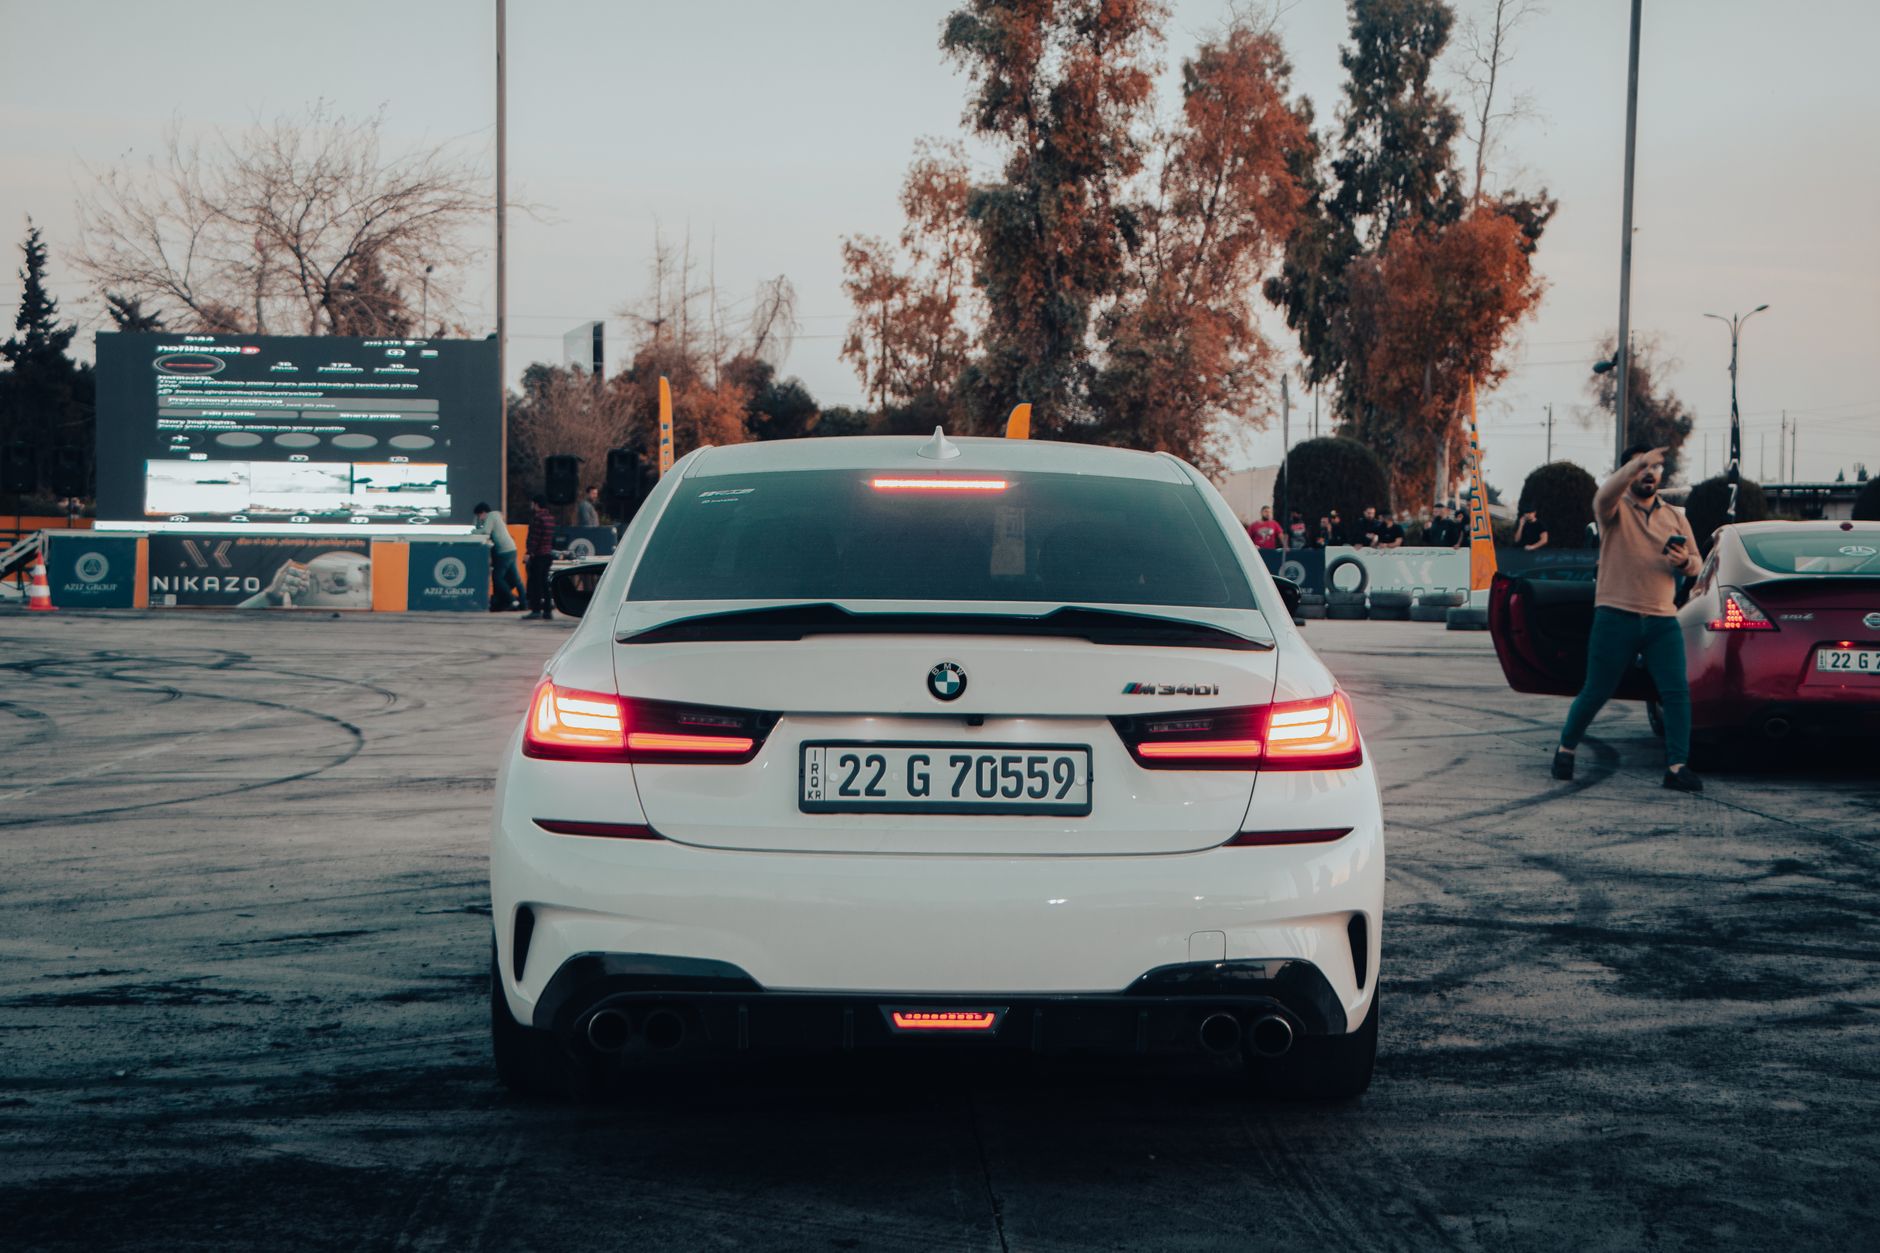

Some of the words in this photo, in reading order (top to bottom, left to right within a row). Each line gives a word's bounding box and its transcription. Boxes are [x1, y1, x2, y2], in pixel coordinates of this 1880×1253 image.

[63, 583, 84, 591] AZIZ
[86, 583, 118, 592] GROUP
[151, 575, 260, 593] NIKAZO
[423, 587, 443, 595] AZIZ
[444, 587, 476, 596] GROUP
[1831, 652, 1851, 668] 22
[1859, 653, 1868, 669] G
[932, 663, 965, 676] BMW
[1122, 682, 1220, 696] M340i
[838, 754, 887, 797] 22
[906, 754, 931, 798] G
[949, 755, 1076, 800] 70559
